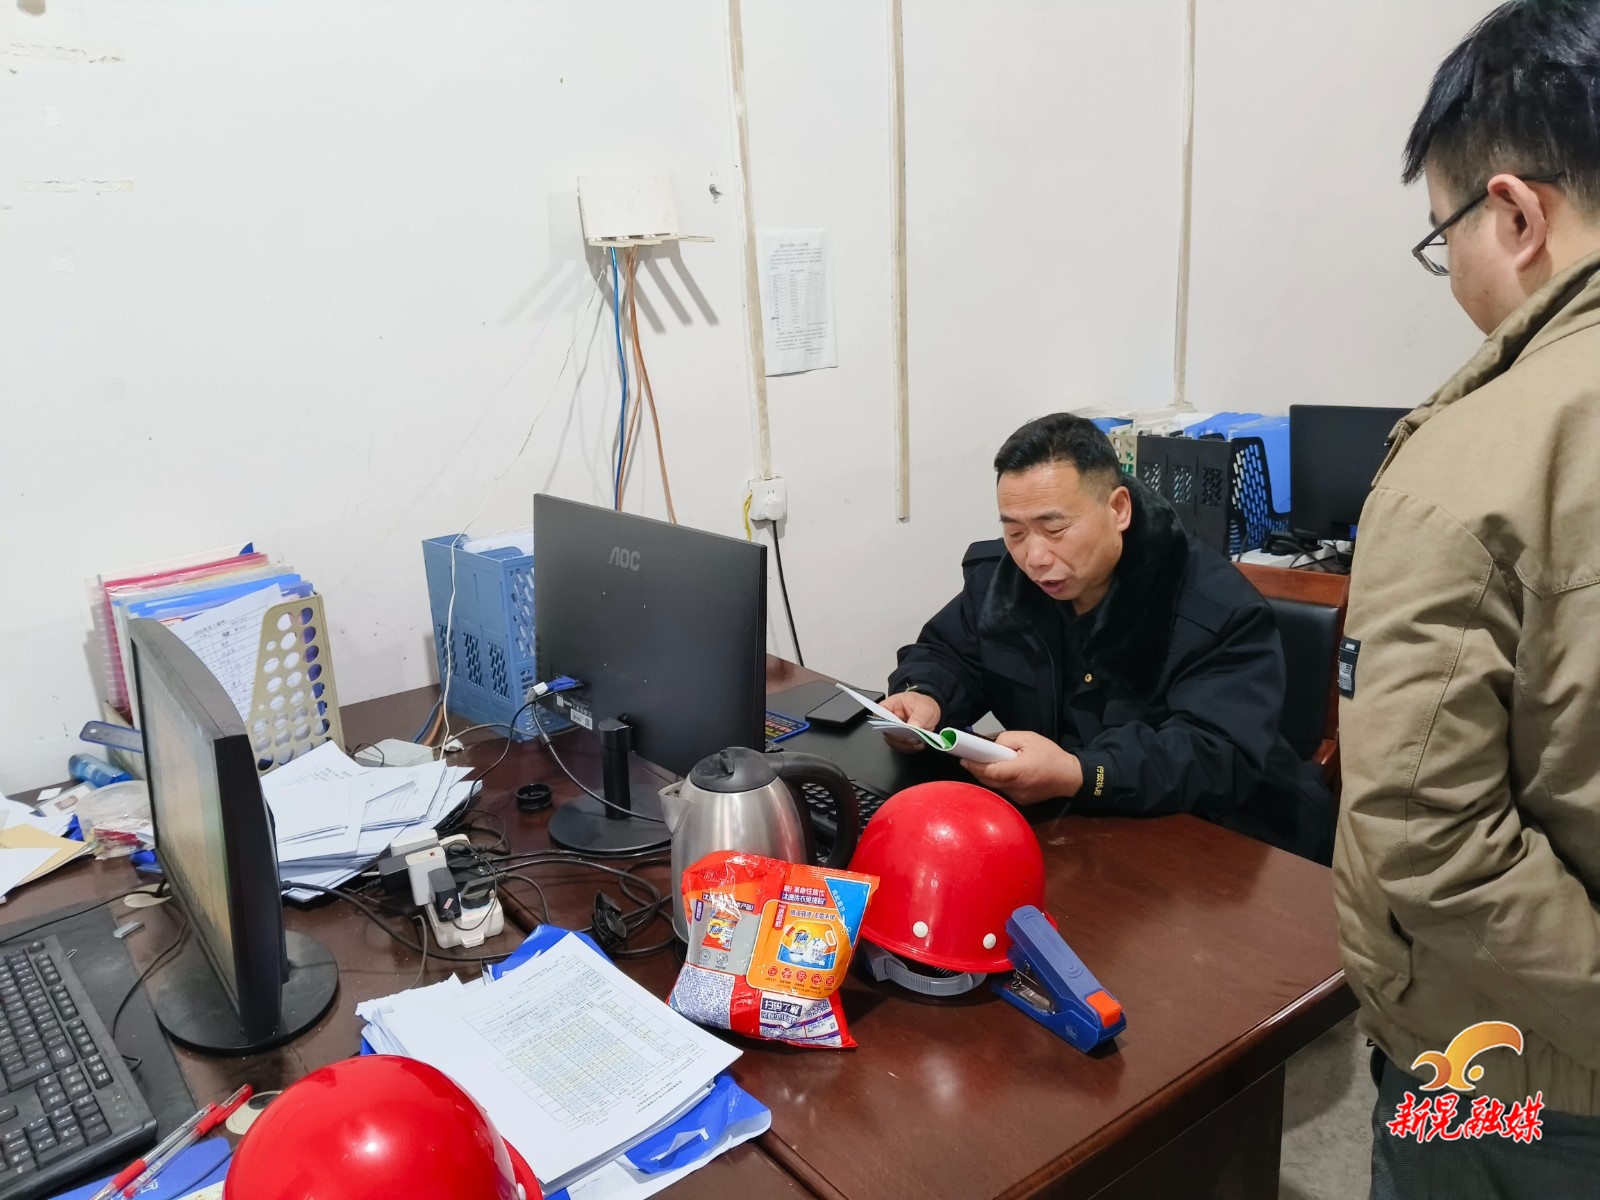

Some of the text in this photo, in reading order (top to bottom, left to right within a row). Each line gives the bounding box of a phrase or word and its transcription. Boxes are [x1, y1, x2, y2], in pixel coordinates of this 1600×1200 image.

[607, 546, 641, 572] AOC
[709, 924, 723, 934] Tide
[793, 932, 809, 943] Tide
[764, 1000, 800, 1015] 扫码了解
